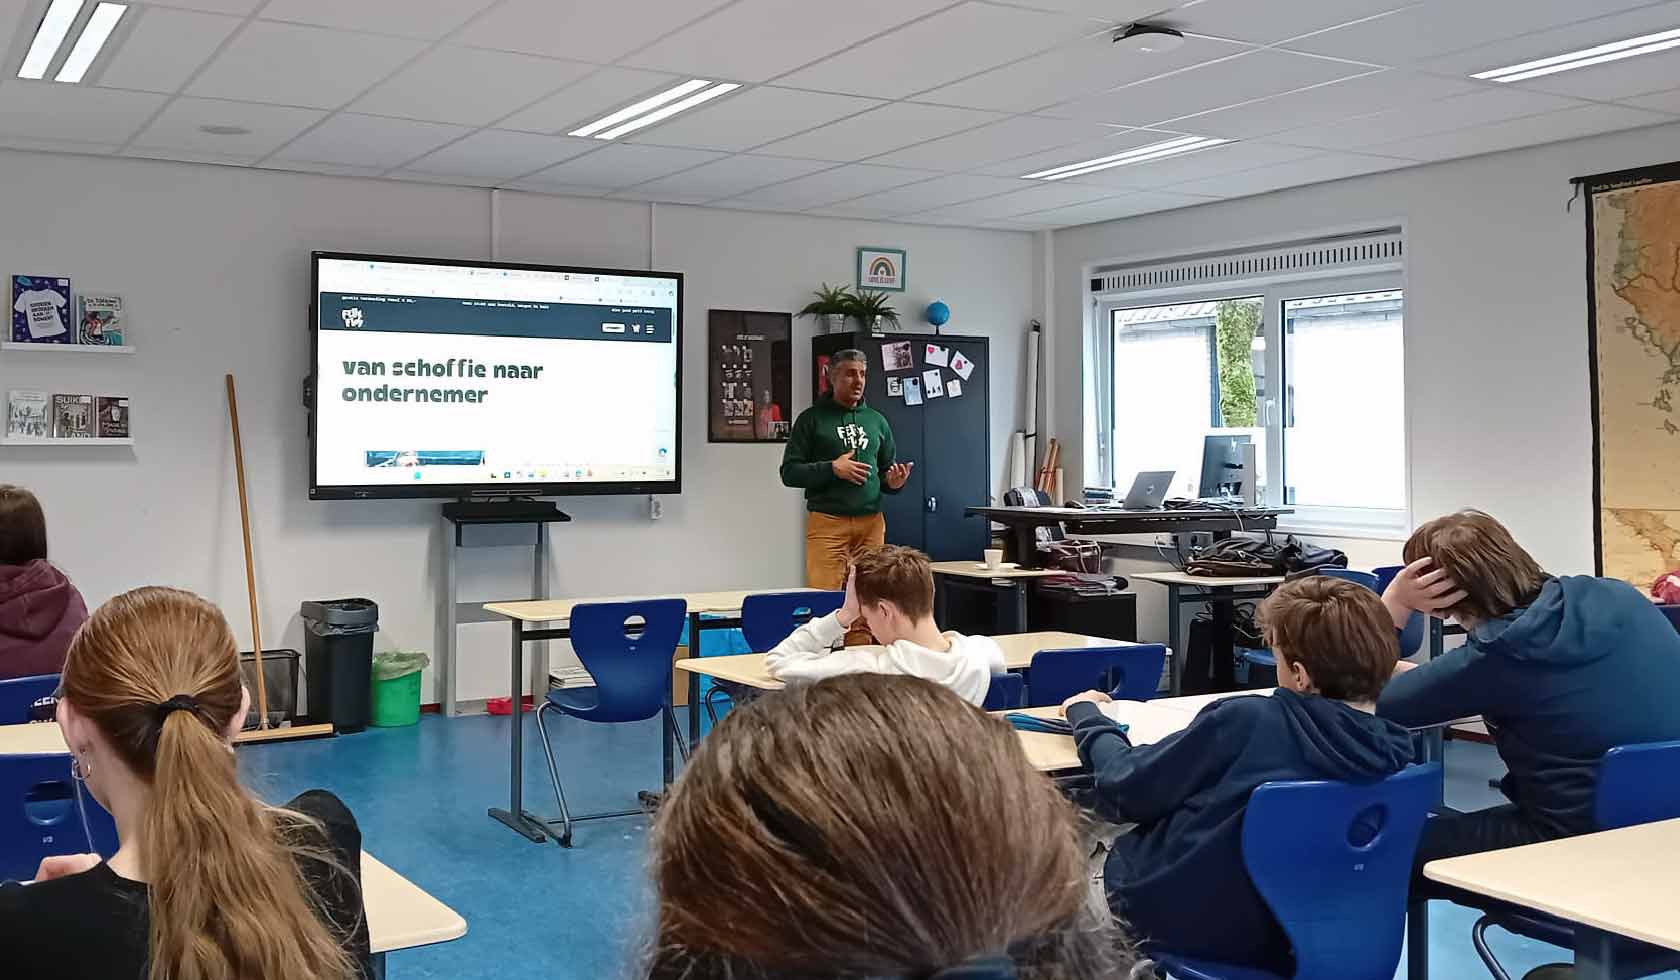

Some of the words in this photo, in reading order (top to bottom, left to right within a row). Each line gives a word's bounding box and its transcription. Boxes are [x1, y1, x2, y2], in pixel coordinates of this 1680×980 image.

[342, 360, 386, 377] van
[391, 358, 487, 379] schoffie
[493, 364, 544, 380] naar
[341, 383, 489, 404] ondernemer
